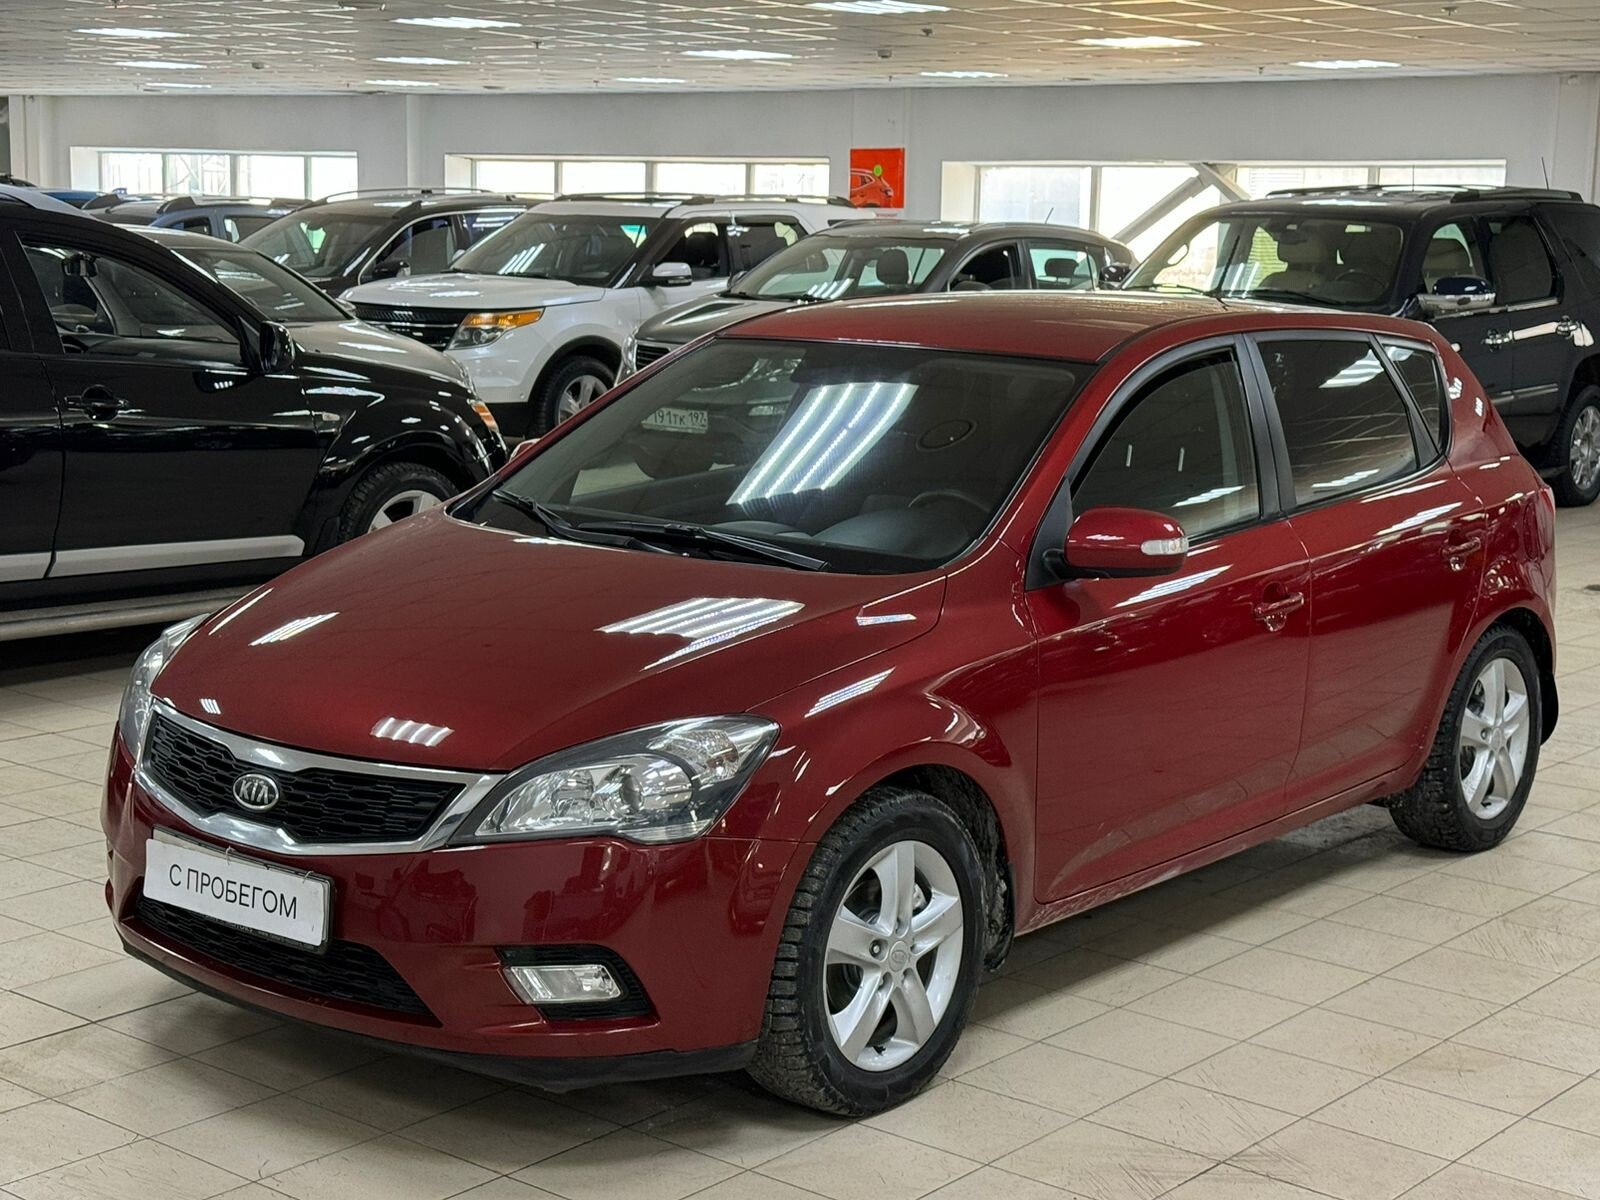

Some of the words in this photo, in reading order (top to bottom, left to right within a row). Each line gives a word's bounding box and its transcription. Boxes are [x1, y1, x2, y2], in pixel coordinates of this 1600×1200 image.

[239, 779, 269, 804] KIA
[169, 863, 182, 887] С
[186, 868, 298, 920] ПРОБЕГОМ
